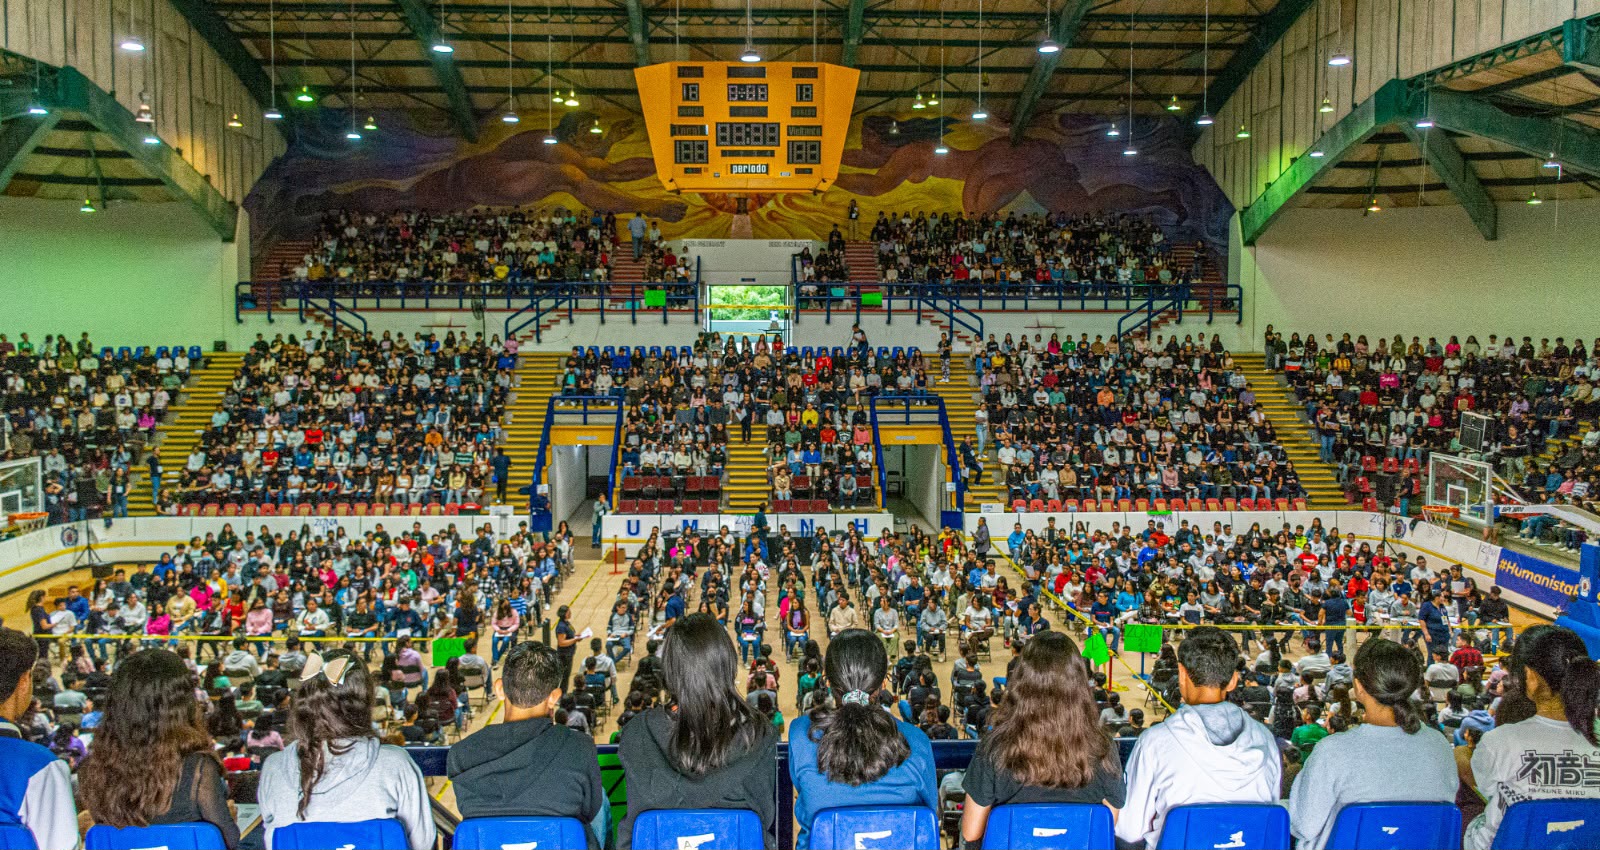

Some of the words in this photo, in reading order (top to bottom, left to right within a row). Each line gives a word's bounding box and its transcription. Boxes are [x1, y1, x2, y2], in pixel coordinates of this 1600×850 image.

[732, 164, 767, 174] periodo
[314, 518, 338, 526] ZONA
[735, 515, 755, 525] ZON
[627, 520, 640, 536] U
[801, 519, 814, 537] N
[855, 518, 868, 534] H
[1126, 625, 1160, 638] ZONA
[436, 639, 461, 651] ZON
